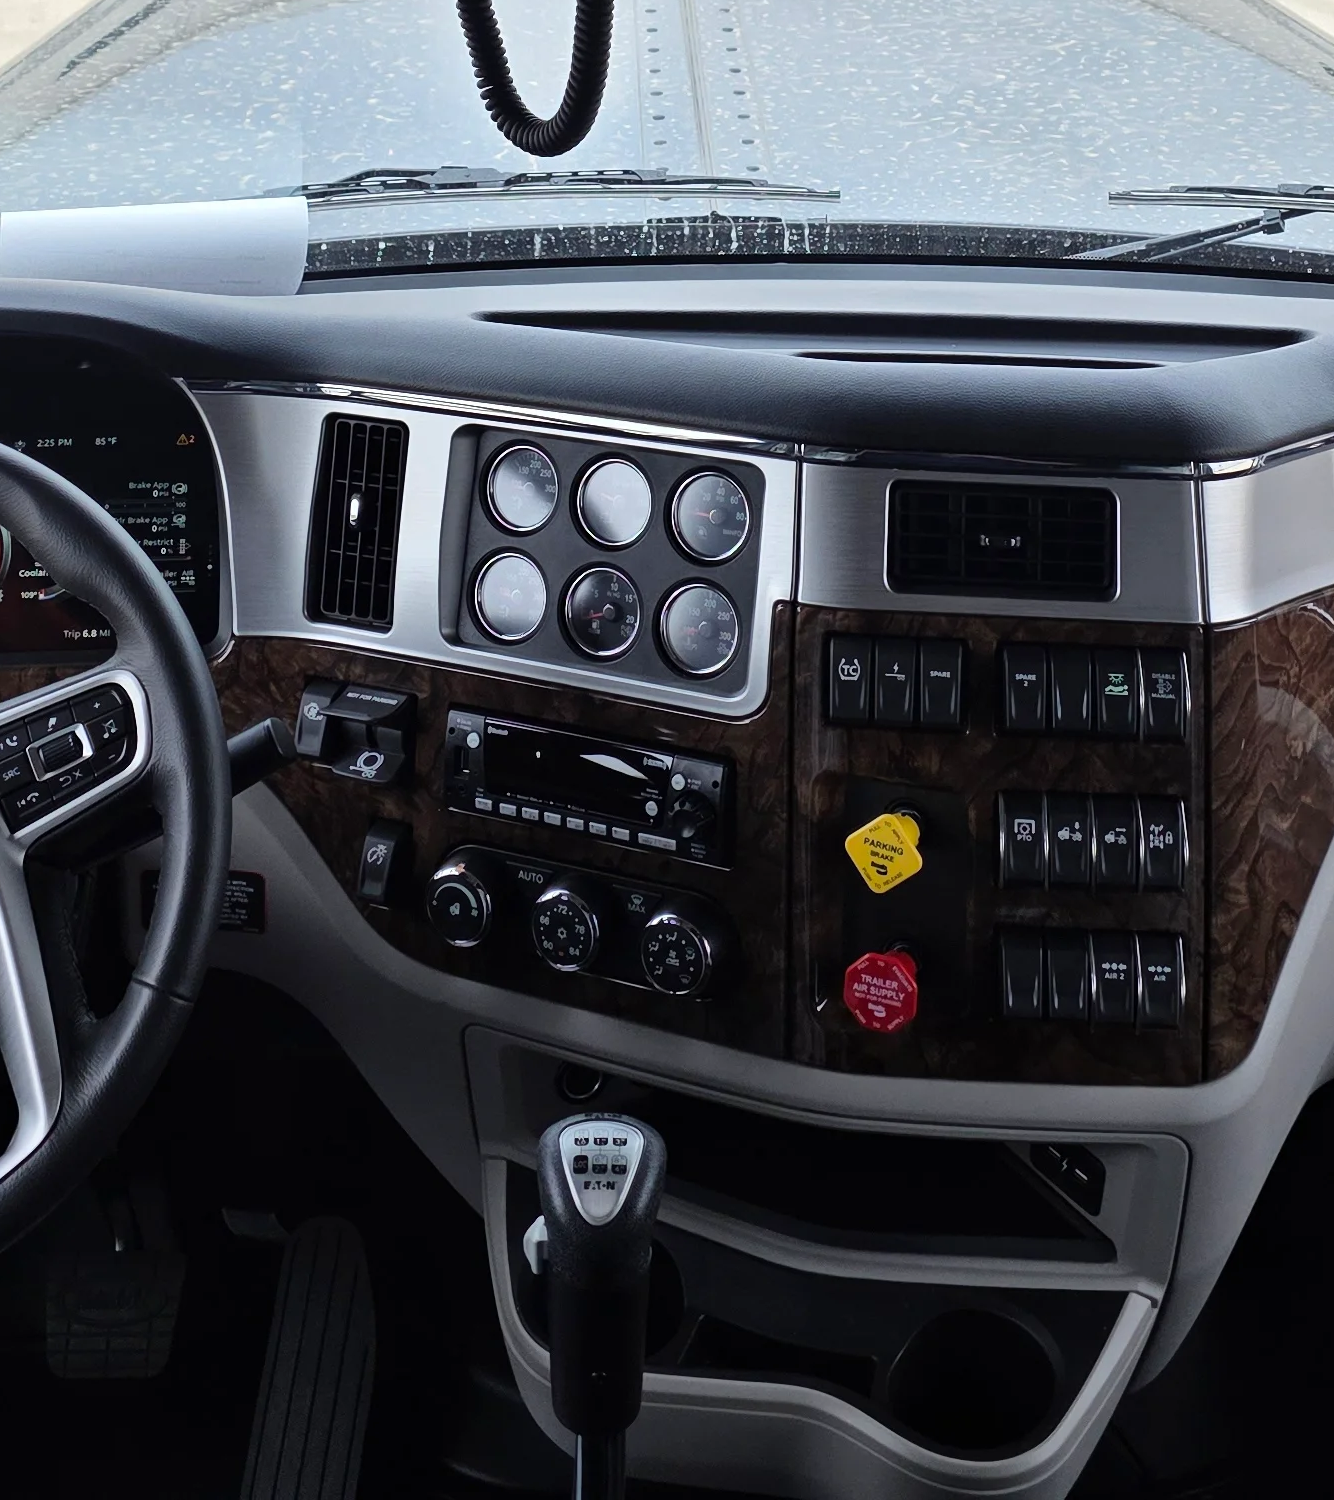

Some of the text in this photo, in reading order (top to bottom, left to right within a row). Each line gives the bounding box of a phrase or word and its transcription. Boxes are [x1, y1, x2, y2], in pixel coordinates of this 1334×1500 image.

[37, 438, 72, 447] 2:25 PM
[129, 481, 169, 490] Brake App
[152, 517, 168, 525] App
[63, 629, 111, 640] Trip 6.8 MI
[930, 670, 951, 679] SPARE
[1015, 673, 1036, 681] SPARE
[2, 767, 21, 781] SRC
[863, 837, 904, 856] PARKING
[870, 850, 894, 863] BRAKE
[517, 870, 544, 884] AUTO
[557, 904, 567, 915] 72
[628, 902, 645, 914] MAX
[860, 973, 899, 990] TRAILER
[1104, 972, 1117, 980] AIR
[852, 982, 905, 1001] AIR SUPPLY
